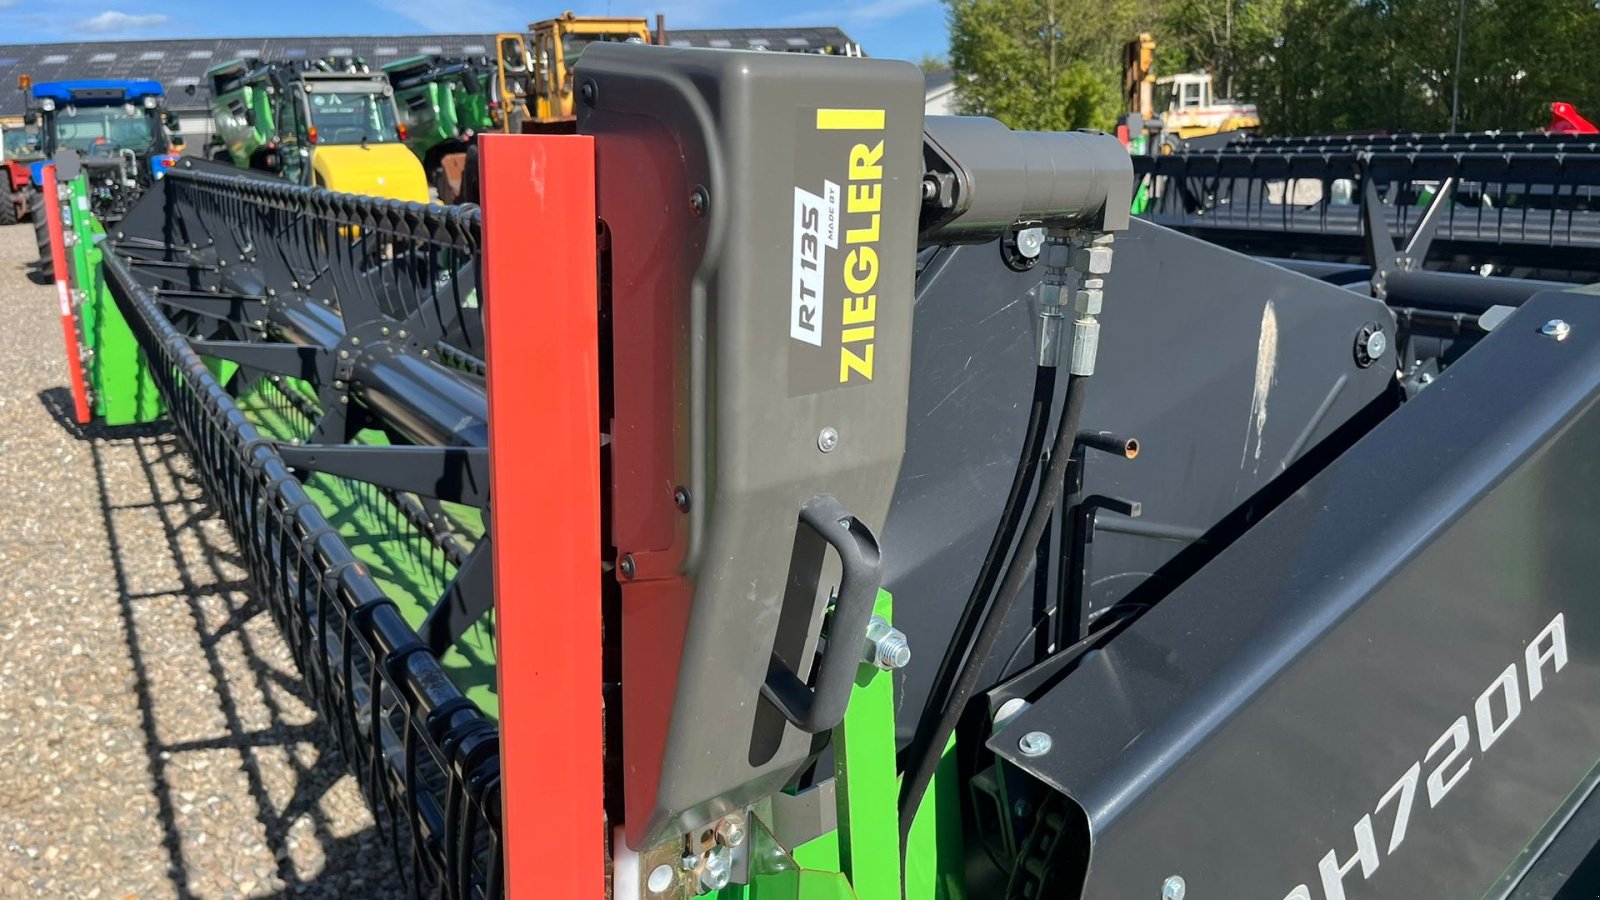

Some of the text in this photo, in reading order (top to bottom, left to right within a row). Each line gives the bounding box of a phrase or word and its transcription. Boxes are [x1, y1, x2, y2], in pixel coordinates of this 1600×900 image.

[827, 187, 836, 240] MADE BY
[840, 139, 884, 383] ZIEGLER
[799, 279, 816, 332] RT
[1283, 612, 1568, 900] H720A
